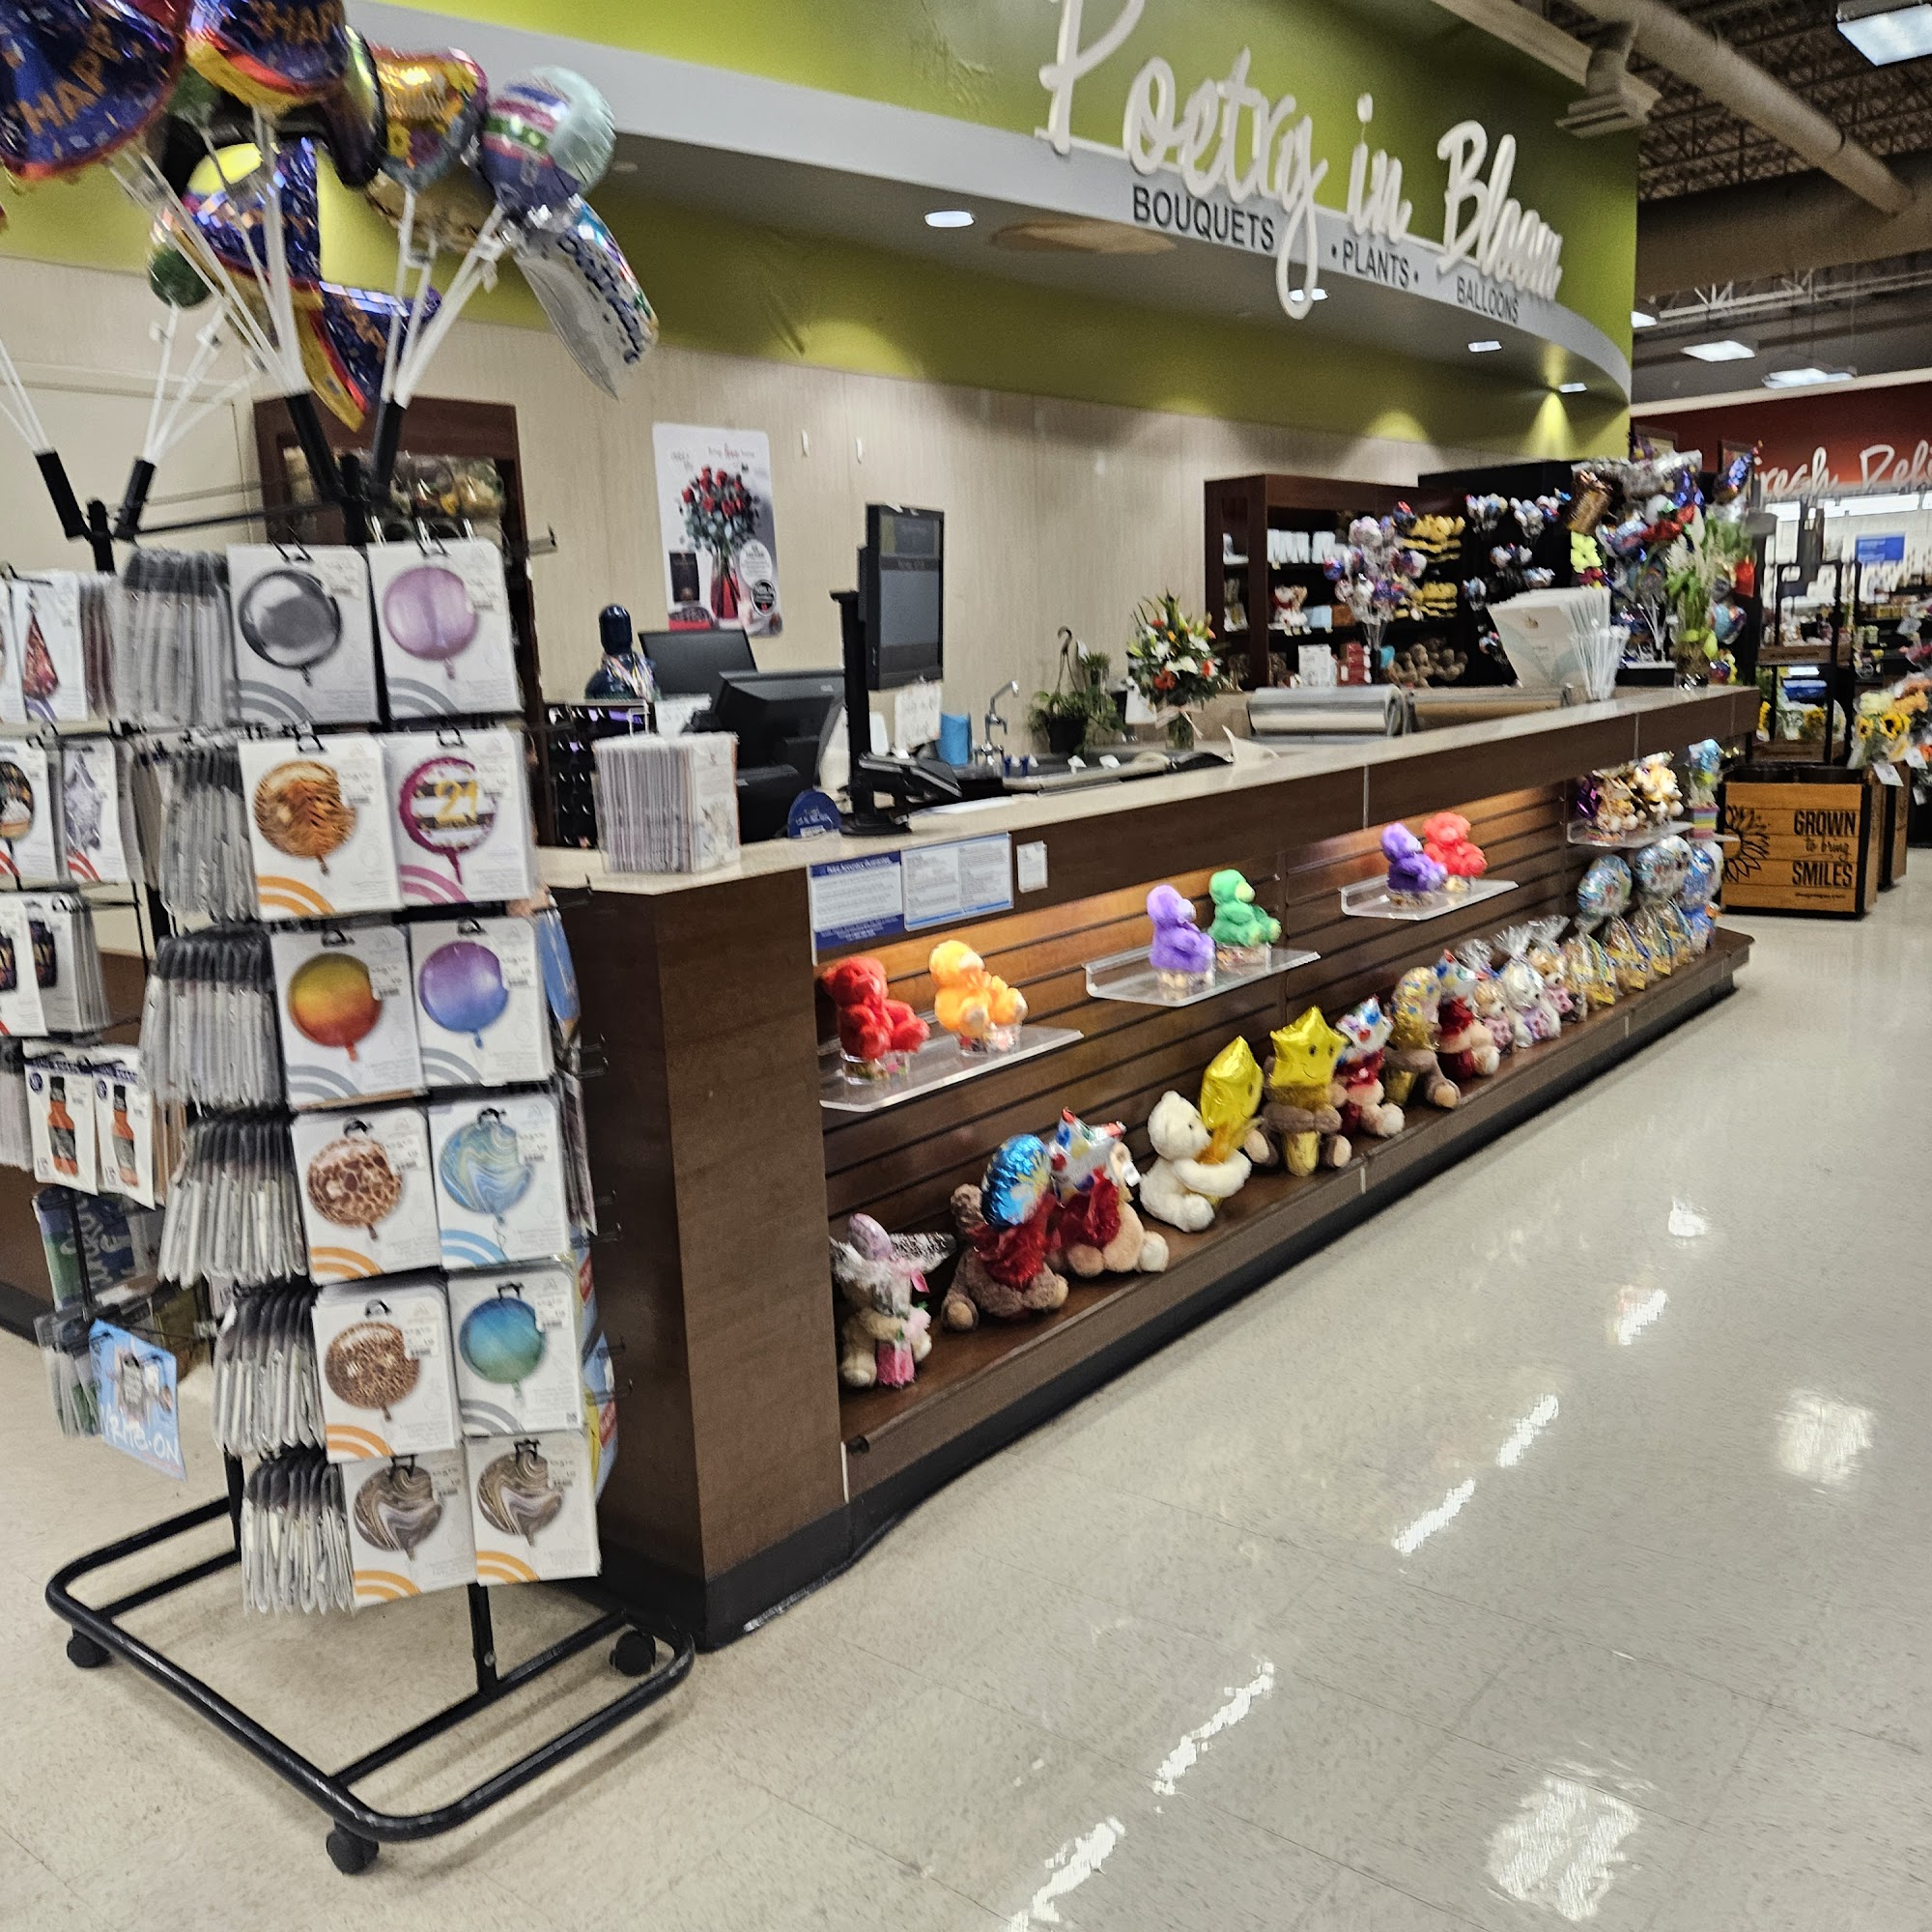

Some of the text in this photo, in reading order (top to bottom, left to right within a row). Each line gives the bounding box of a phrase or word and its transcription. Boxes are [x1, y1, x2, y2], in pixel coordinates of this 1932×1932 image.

[1035, 0, 1328, 320] Poetry
[1348, 94, 1412, 242] in
[1133, 185, 1274, 252] BOUQUETS
[1342, 238, 1409, 289] PLANTS
[1456, 275, 1520, 324] BALLOONS
[1759, 446, 1839, 498] resh
[1794, 810, 1856, 837] GROWN
[1792, 861, 1853, 887] SMILES
